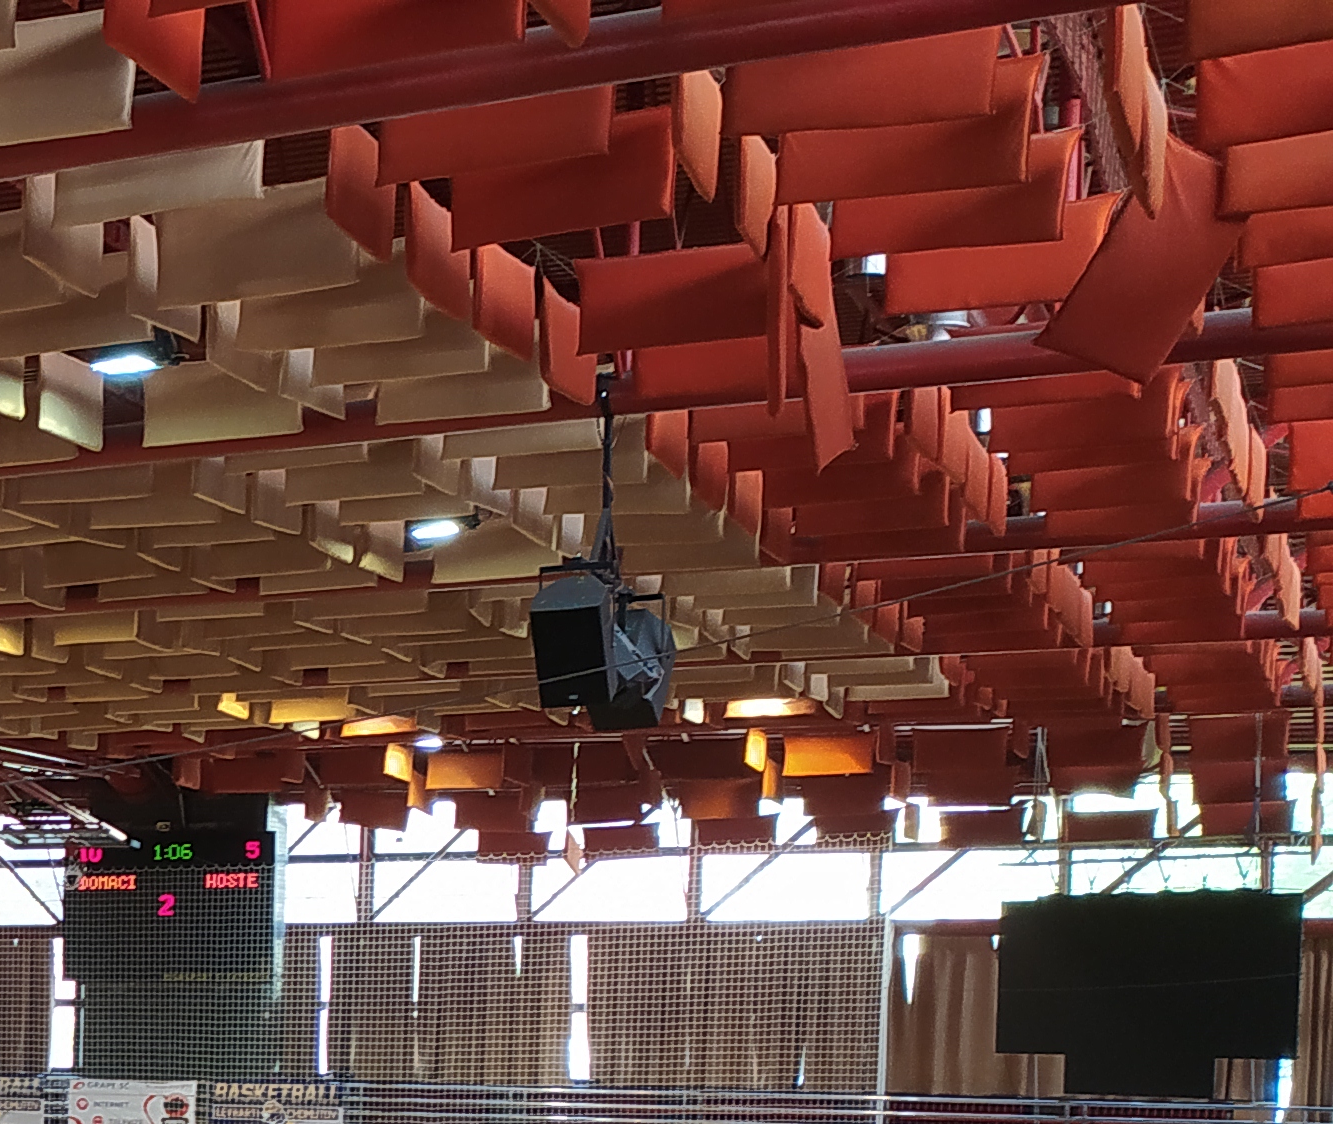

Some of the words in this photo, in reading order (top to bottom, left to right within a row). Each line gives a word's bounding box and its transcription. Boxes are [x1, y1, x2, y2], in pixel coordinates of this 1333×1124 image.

[153, 844, 193, 861] 1:06
[245, 841, 261, 859] 5
[205, 873, 259, 889] HOSTE
[157, 894, 175, 916] 2
[215, 1082, 340, 1105] BASKETBALL
